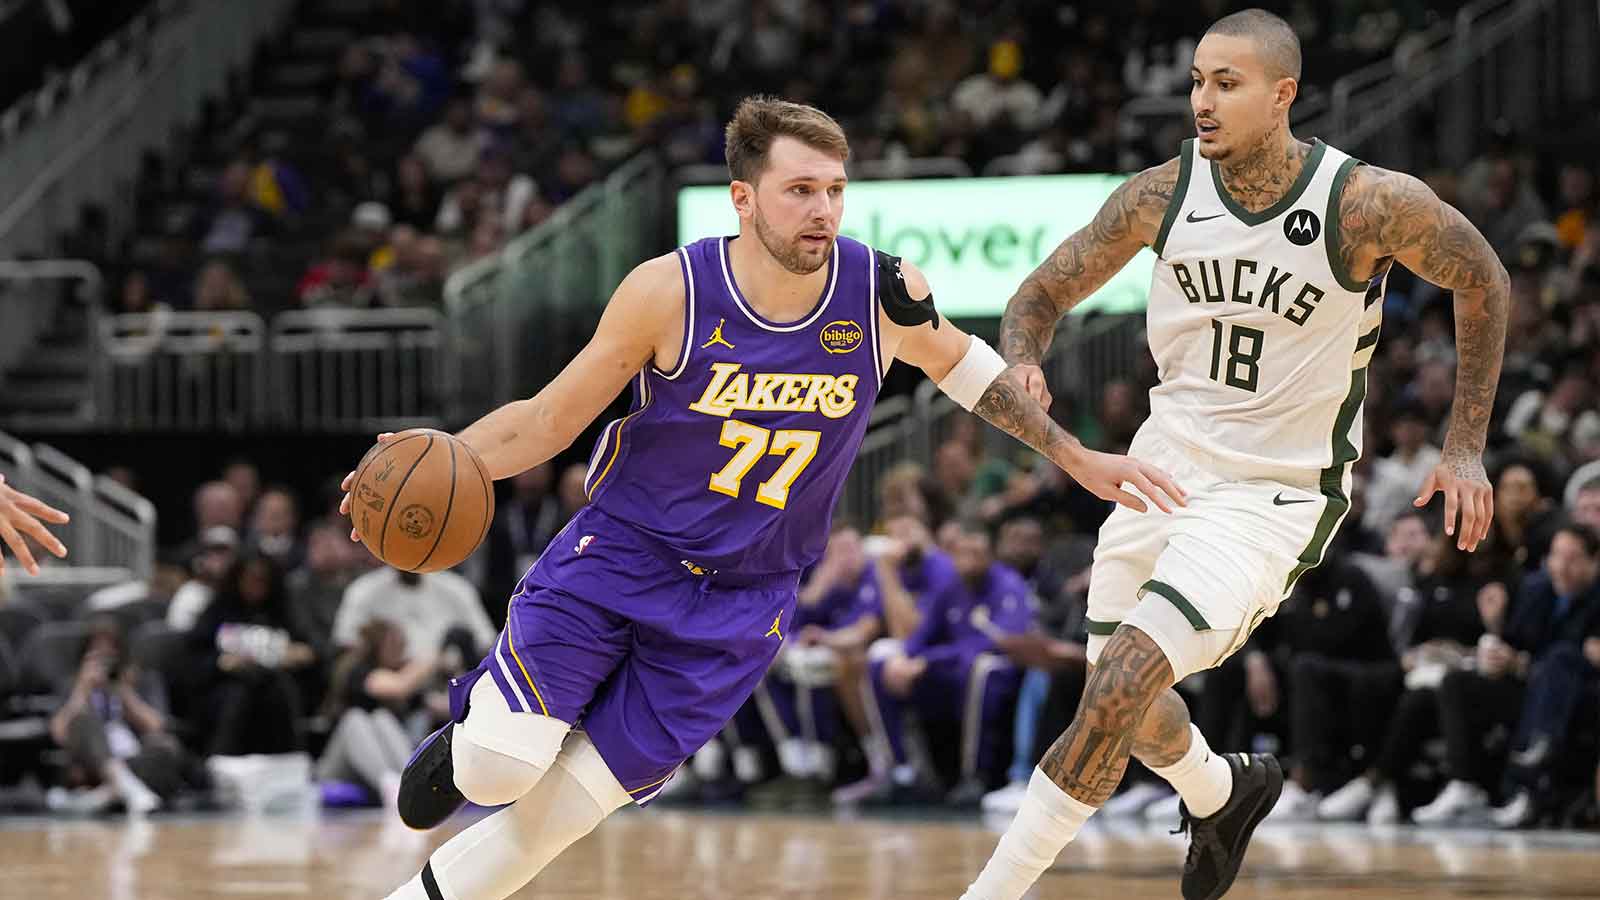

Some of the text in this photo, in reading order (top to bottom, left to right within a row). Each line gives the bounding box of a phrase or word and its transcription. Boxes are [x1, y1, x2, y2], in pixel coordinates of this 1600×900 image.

[1172, 258, 1326, 327] BUCKS
[824, 329, 861, 344] bibigo
[1209, 318, 1265, 393] 18
[688, 362, 859, 419] LAKERS
[708, 419, 822, 510] 77
